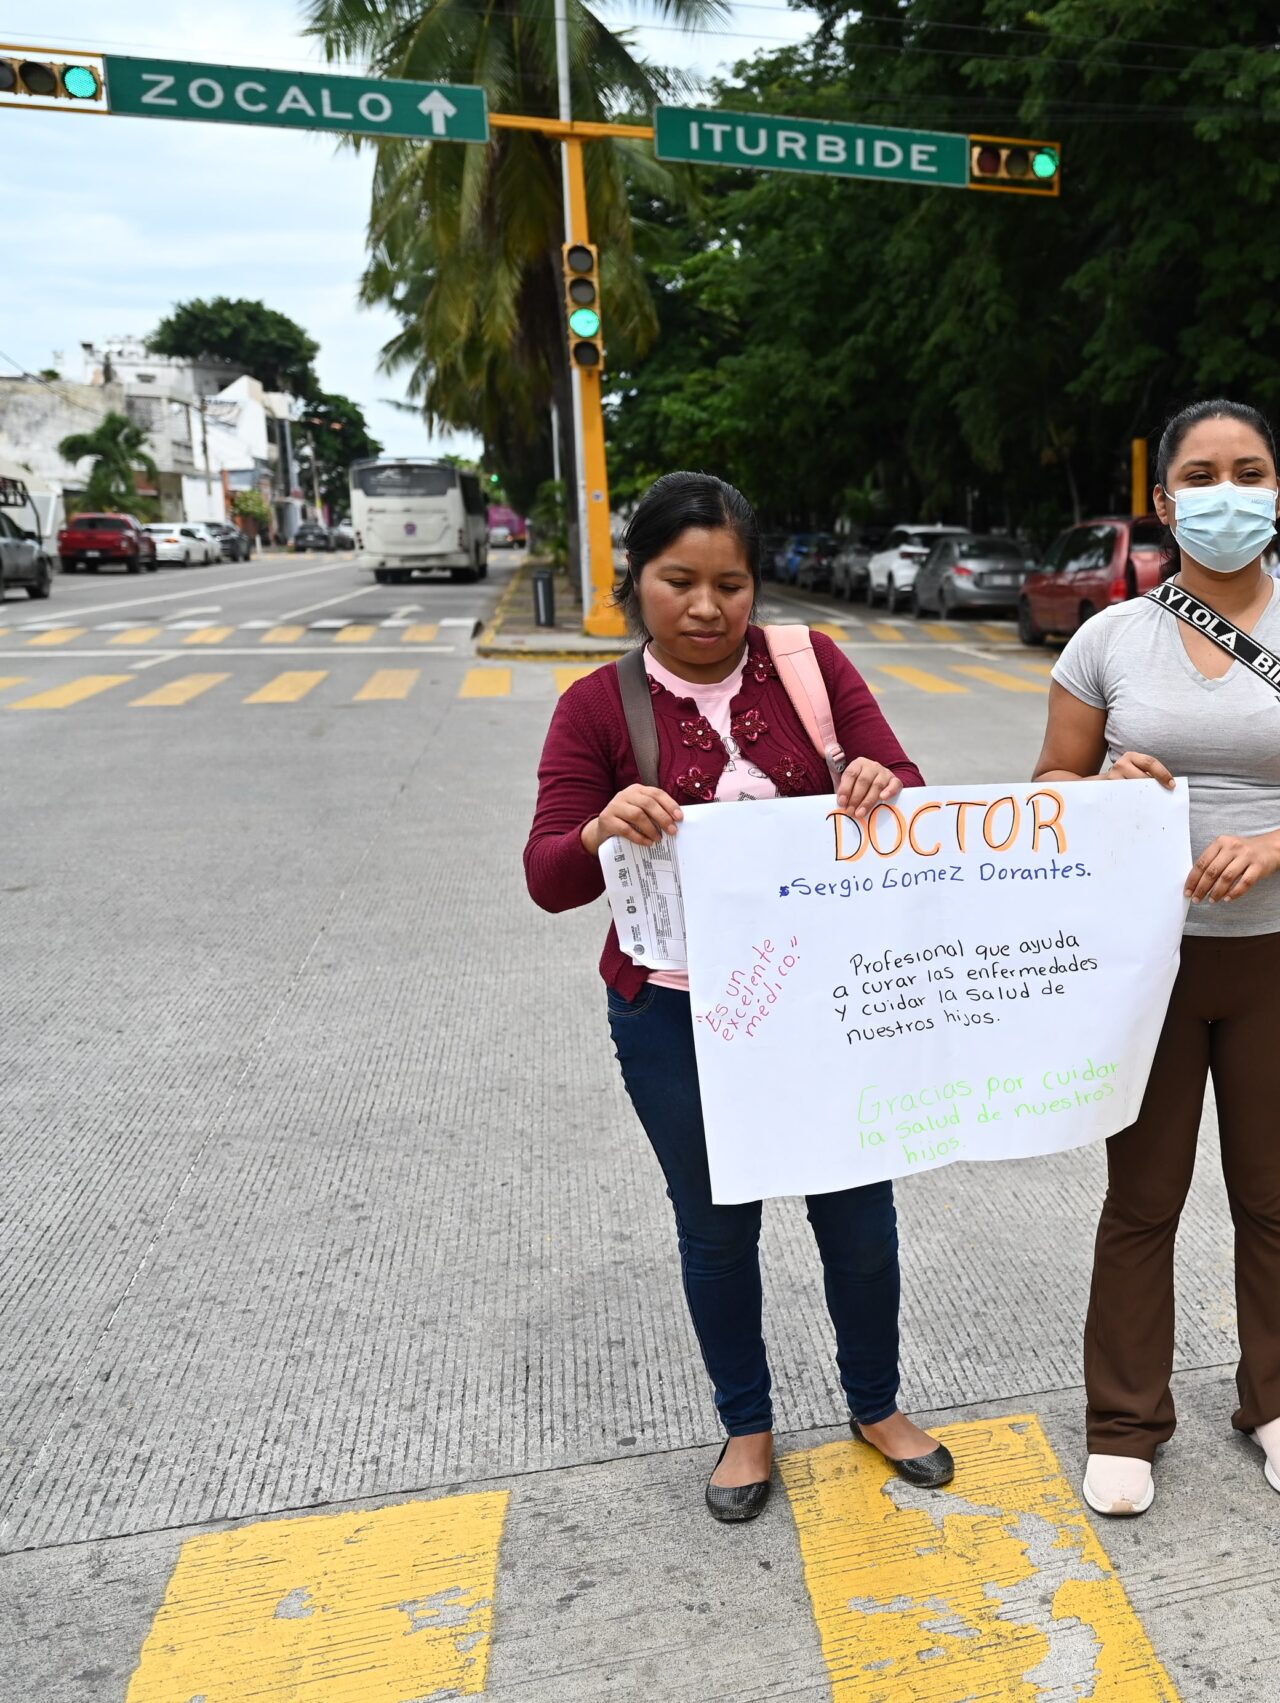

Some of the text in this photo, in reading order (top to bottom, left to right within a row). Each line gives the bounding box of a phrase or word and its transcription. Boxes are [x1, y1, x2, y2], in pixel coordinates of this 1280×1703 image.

[141, 73, 393, 122] ZOCALO
[689, 121, 938, 173] ITURBIDE
[825, 788, 1068, 863] DOCTOR
[791, 875, 873, 898] Sergio
[979, 859, 1091, 881] Dorantes.
[833, 954, 1098, 999] a curar las enfermedades
[850, 930, 1080, 976] Profesional que ayuda
[722, 939, 775, 1042] excelente
[726, 970, 746, 997] un
[862, 993, 926, 1016] cuidar
[939, 989, 958, 1003] la
[1041, 980, 1065, 995] de
[846, 1009, 1000, 1045] nuestros hijos.
[857, 1057, 1120, 1125] Gracias por cuidar
[859, 1131, 886, 1149] la
[977, 1103, 1002, 1123] de
[1014, 1082, 1116, 1118] nuestros
